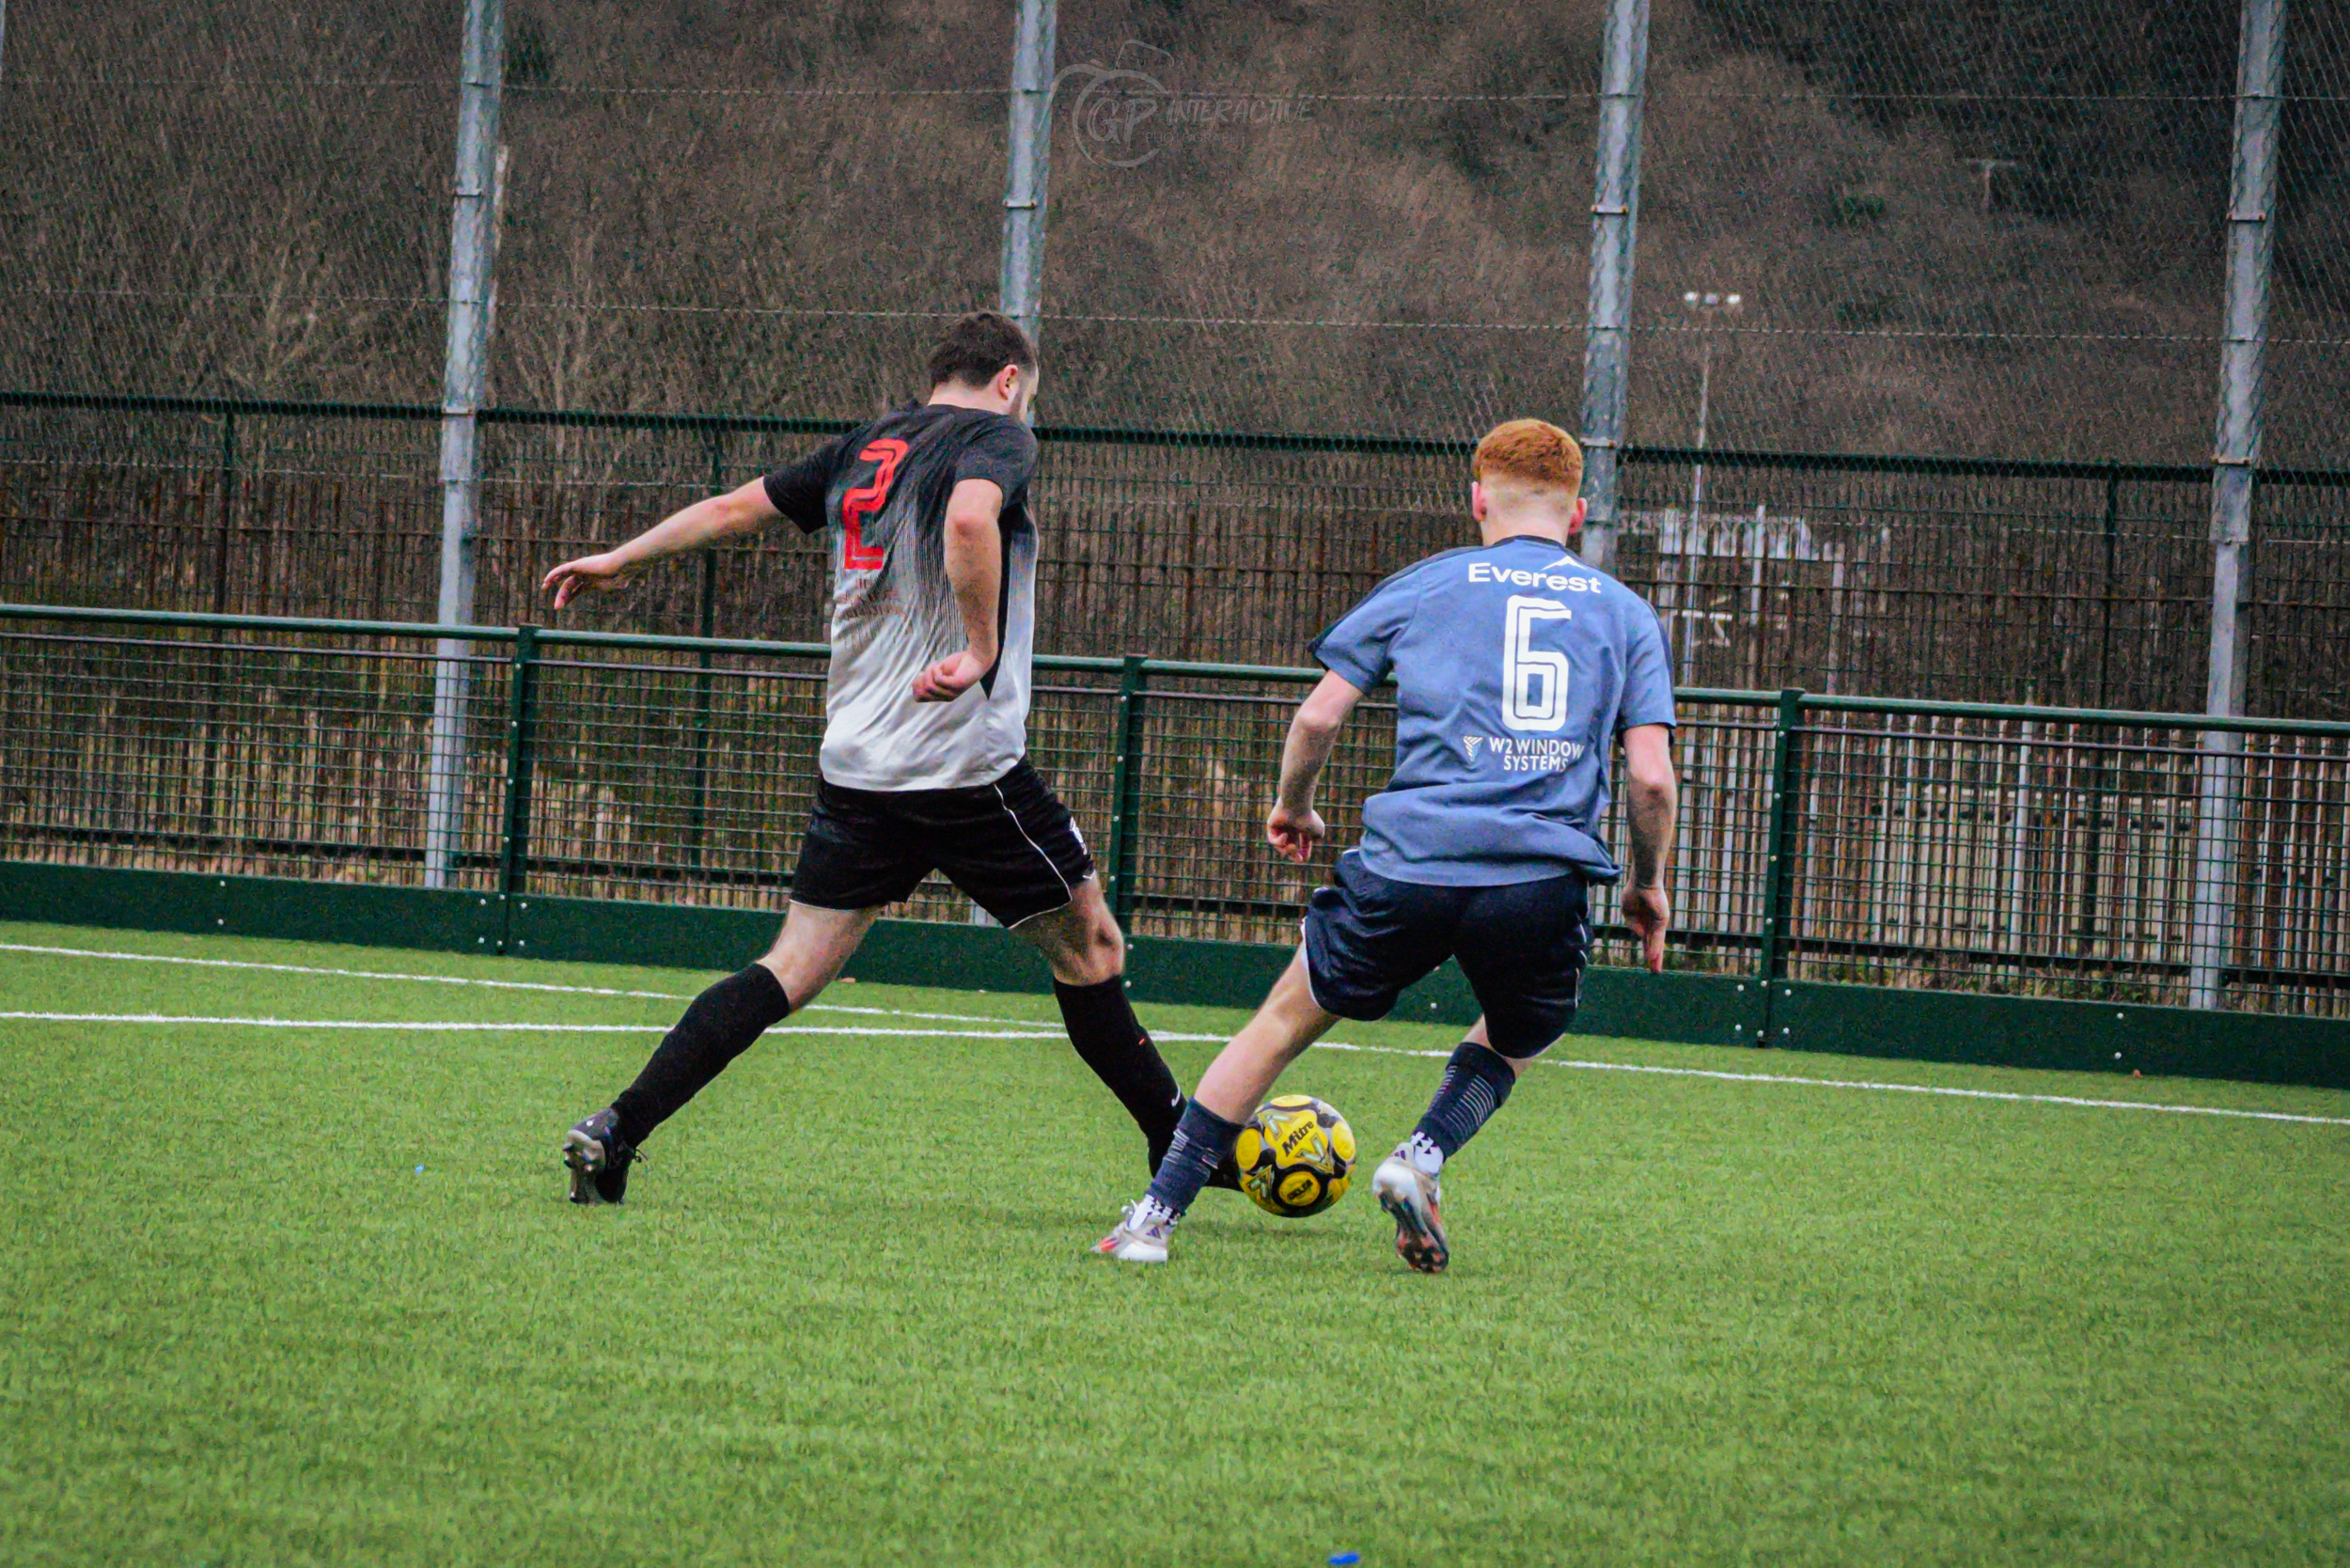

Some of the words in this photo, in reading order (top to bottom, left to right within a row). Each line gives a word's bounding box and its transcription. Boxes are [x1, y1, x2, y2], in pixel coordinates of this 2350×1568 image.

[843, 438, 909, 570] 2
[1468, 562, 1602, 594] Everest
[1501, 594, 1572, 731] 6
[1489, 737, 1513, 755] W2
[1515, 739, 1585, 760] WINDOW
[1503, 755, 1569, 772] SYSTEMS
[1281, 1121, 1315, 1157] Mitre
